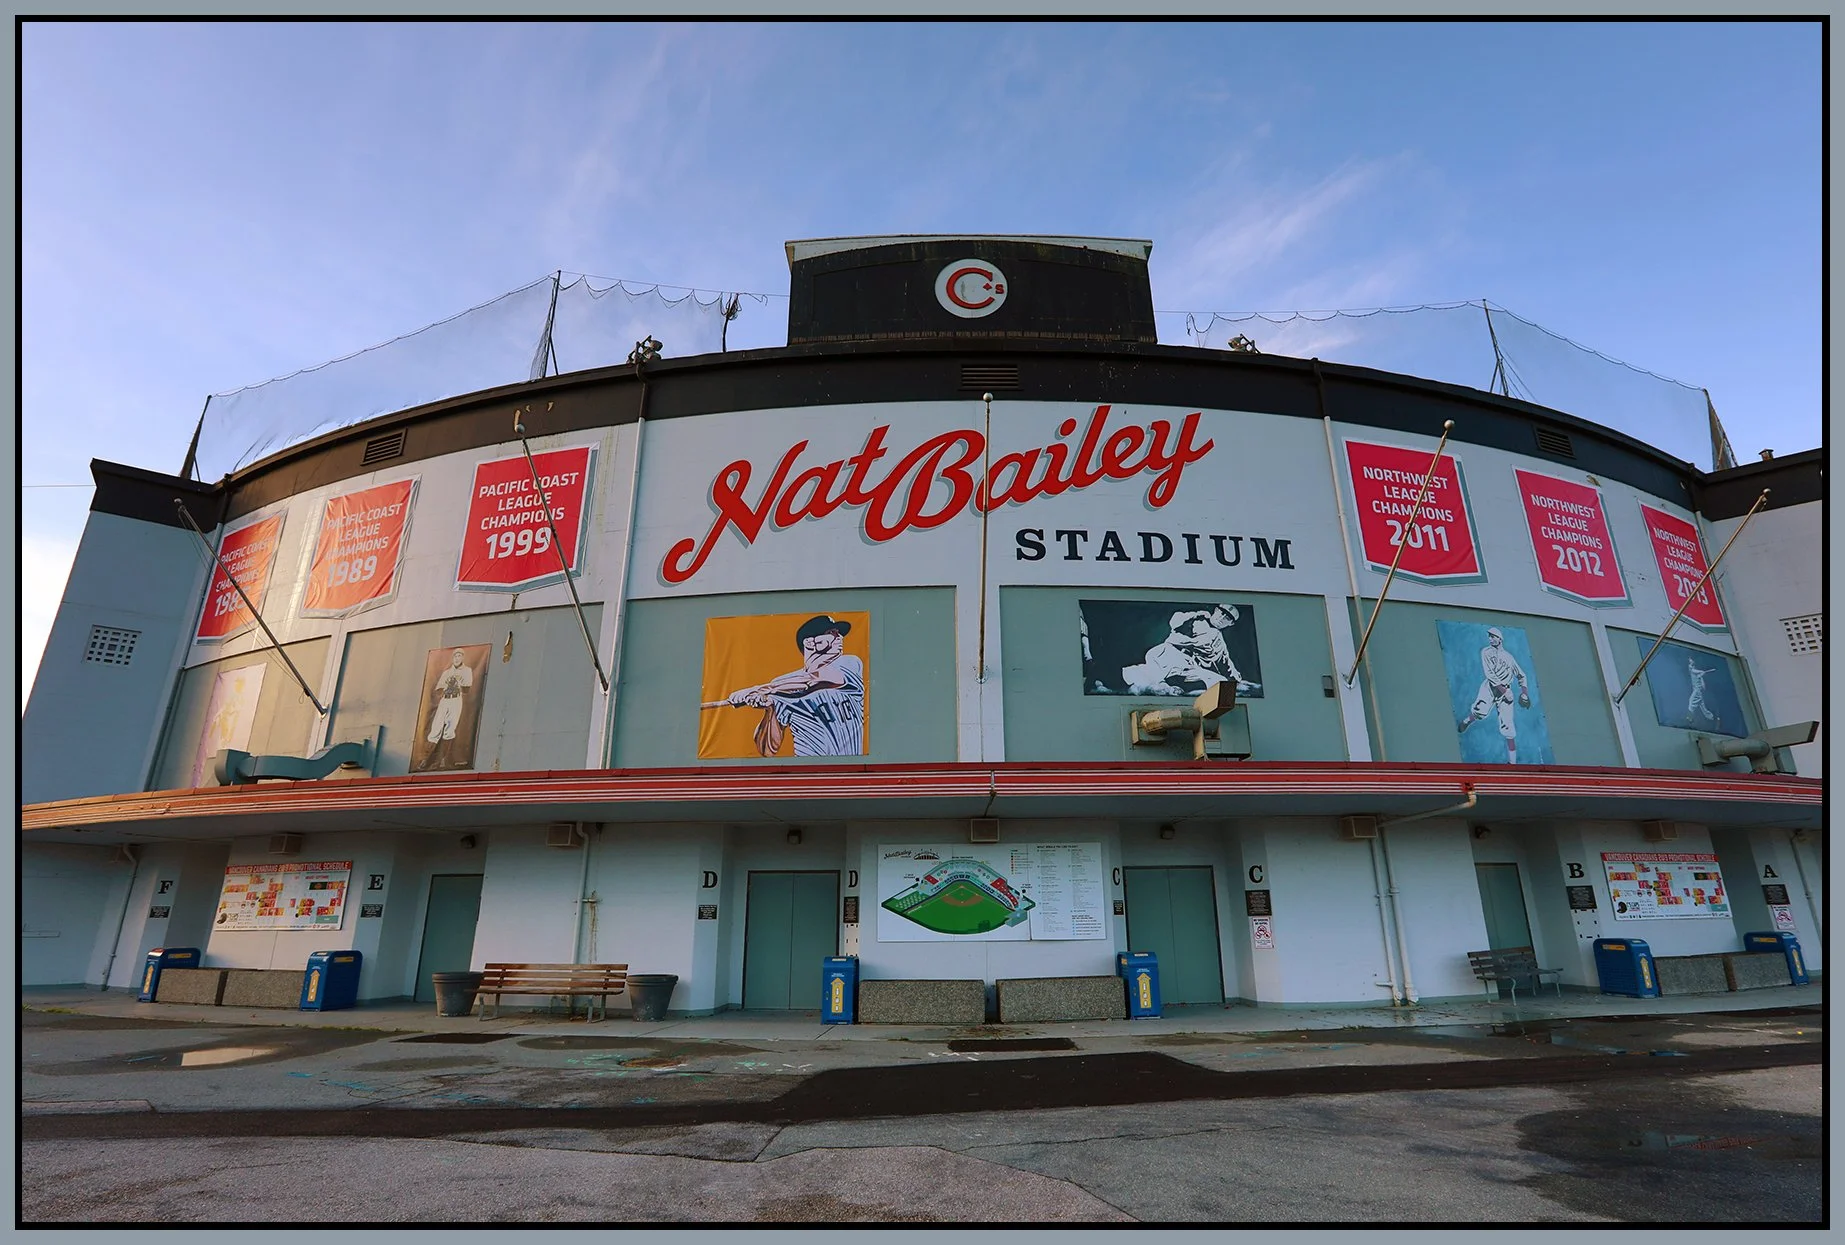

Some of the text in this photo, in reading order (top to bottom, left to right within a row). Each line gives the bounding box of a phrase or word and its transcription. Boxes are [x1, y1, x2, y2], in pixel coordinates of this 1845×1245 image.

[479, 472, 579, 498] PACIFIC COAST
[662, 405, 1214, 584] Nat Bailey
[498, 492, 552, 511] LEAGUE
[1531, 494, 1595, 519] NORTHWEST
[327, 502, 403, 529] PACIFIC COAST
[481, 507, 565, 530] CHAMPIONS
[1548, 512, 1589, 532] LEAGUE
[339, 523, 381, 542] LEAGUE
[485, 526, 552, 560] 1999
[1386, 520, 1450, 552] 2011
[1541, 526, 1603, 550] CHAMPIONS
[1653, 527, 1697, 552] NORTHWEST
[220, 545, 247, 564] PACIFIC
[326, 536, 389, 560] CHAMPIONS
[1015, 529, 1296, 570] STADIUM
[1666, 545, 1695, 564] LEAGUE
[327, 555, 378, 588] 1989
[1552, 544, 1605, 577] 2012
[1663, 557, 1705, 580] CHAMPIONS
[1673, 574, 1709, 605] 2013
[253, 865, 278, 873] CANADIANS
[323, 861, 349, 871] SCHEDULE
[1112, 867, 1121, 886] C
[1249, 865, 1263, 883] C
[1566, 862, 1585, 879] B
[1763, 864, 1778, 878] A
[158, 880, 173, 894] F
[367, 874, 385, 890] E
[702, 870, 718, 888] D
[848, 870, 859, 888] D
